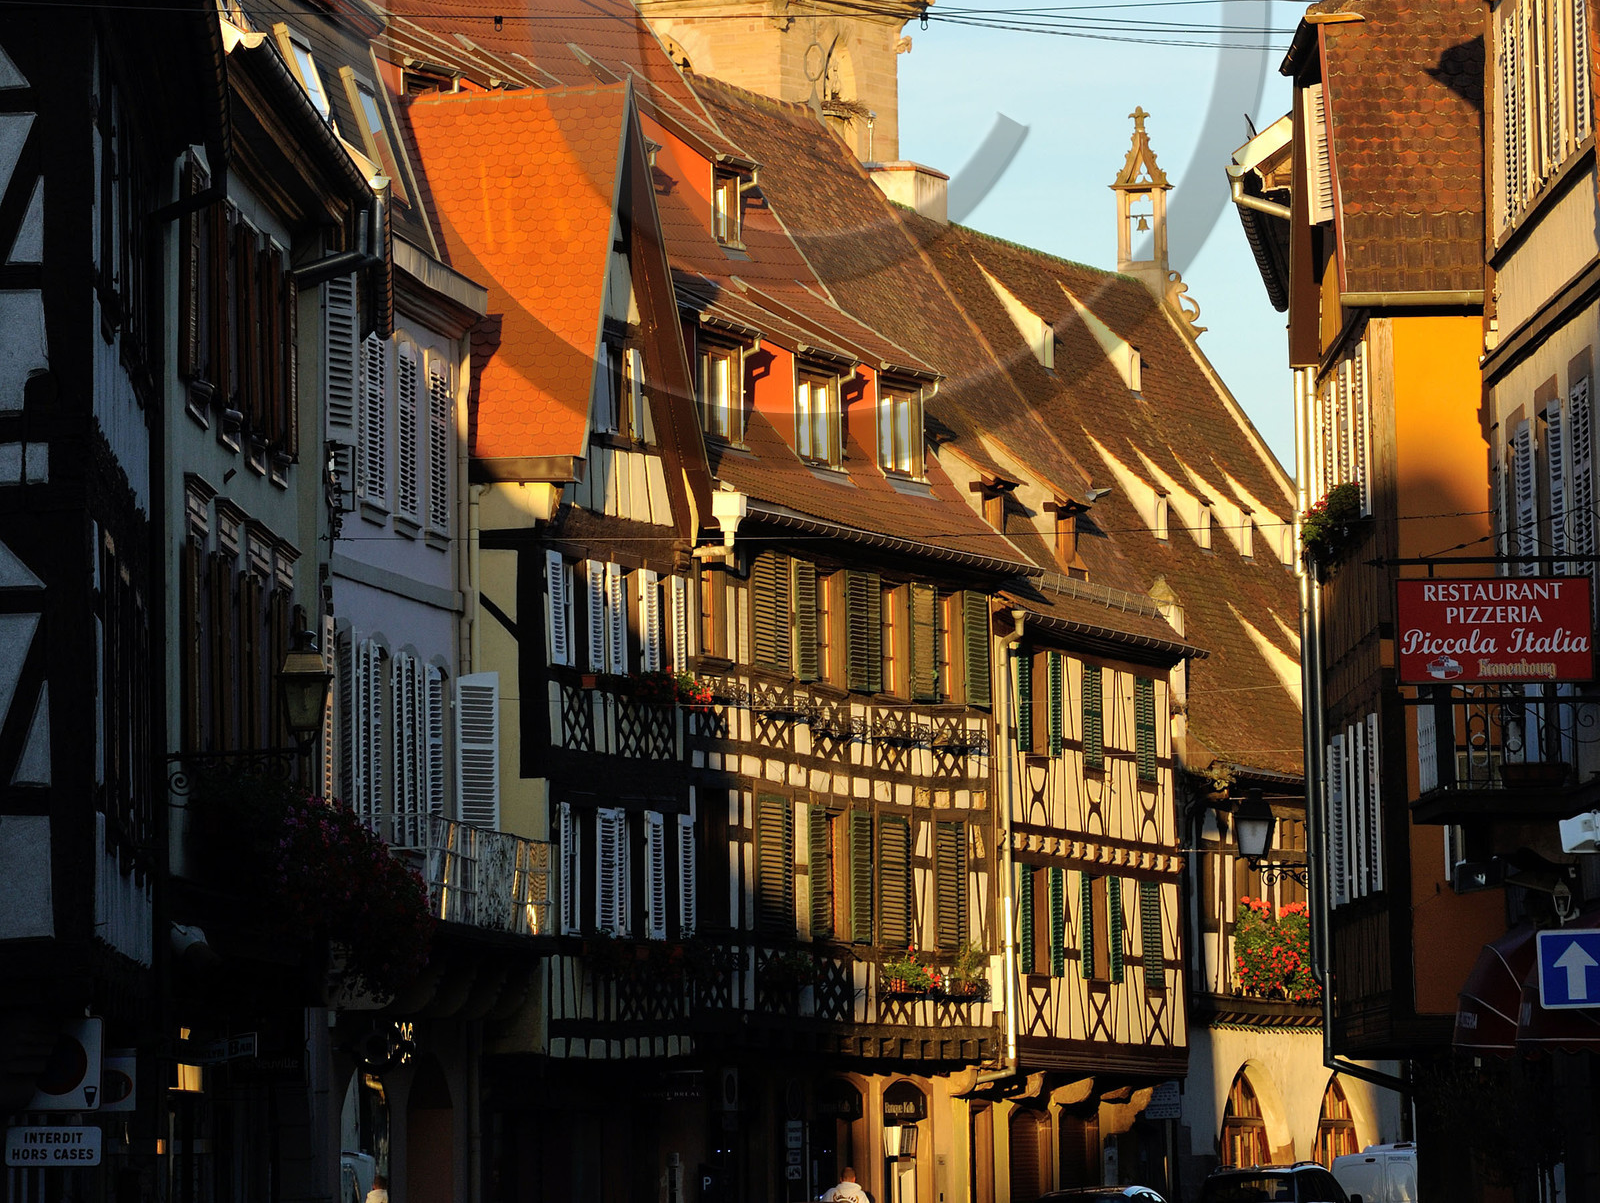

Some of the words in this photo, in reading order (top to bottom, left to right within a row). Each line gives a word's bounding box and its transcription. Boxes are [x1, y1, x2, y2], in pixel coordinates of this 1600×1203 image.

[1423, 582, 1563, 602] RESTAURANT
[1446, 605, 1543, 624] PIZZERIA
[1401, 628, 1498, 655] Piccola
[1506, 627, 1590, 654] Italia
[1477, 658, 1558, 679] Kronenbourg
[24, 1132, 83, 1144] INTERDIT
[12, 1149, 48, 1160] HORS
[53, 1149, 94, 1160] CASES
